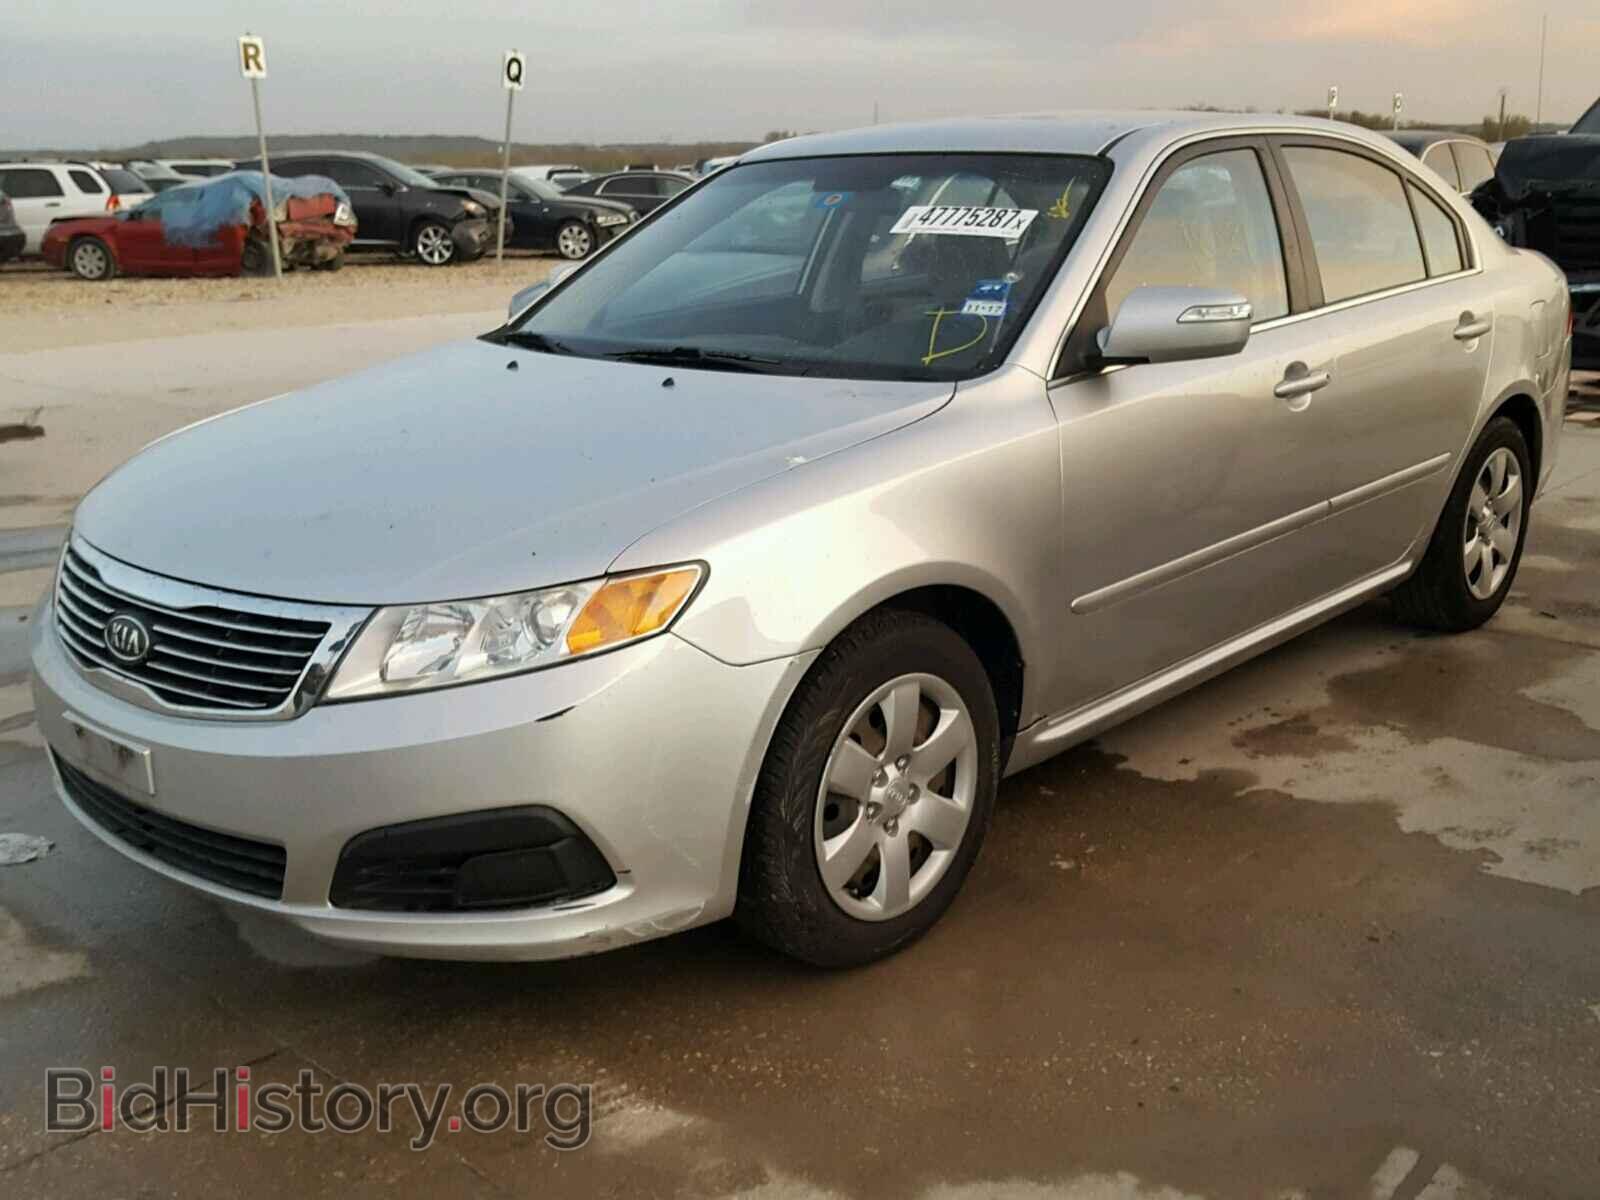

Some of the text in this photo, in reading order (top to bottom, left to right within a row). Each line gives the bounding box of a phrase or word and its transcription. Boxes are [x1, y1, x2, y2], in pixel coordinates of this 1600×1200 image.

[243, 42, 263, 71] R
[506, 57, 522, 86] Q
[112, 622, 139, 654] KIA
